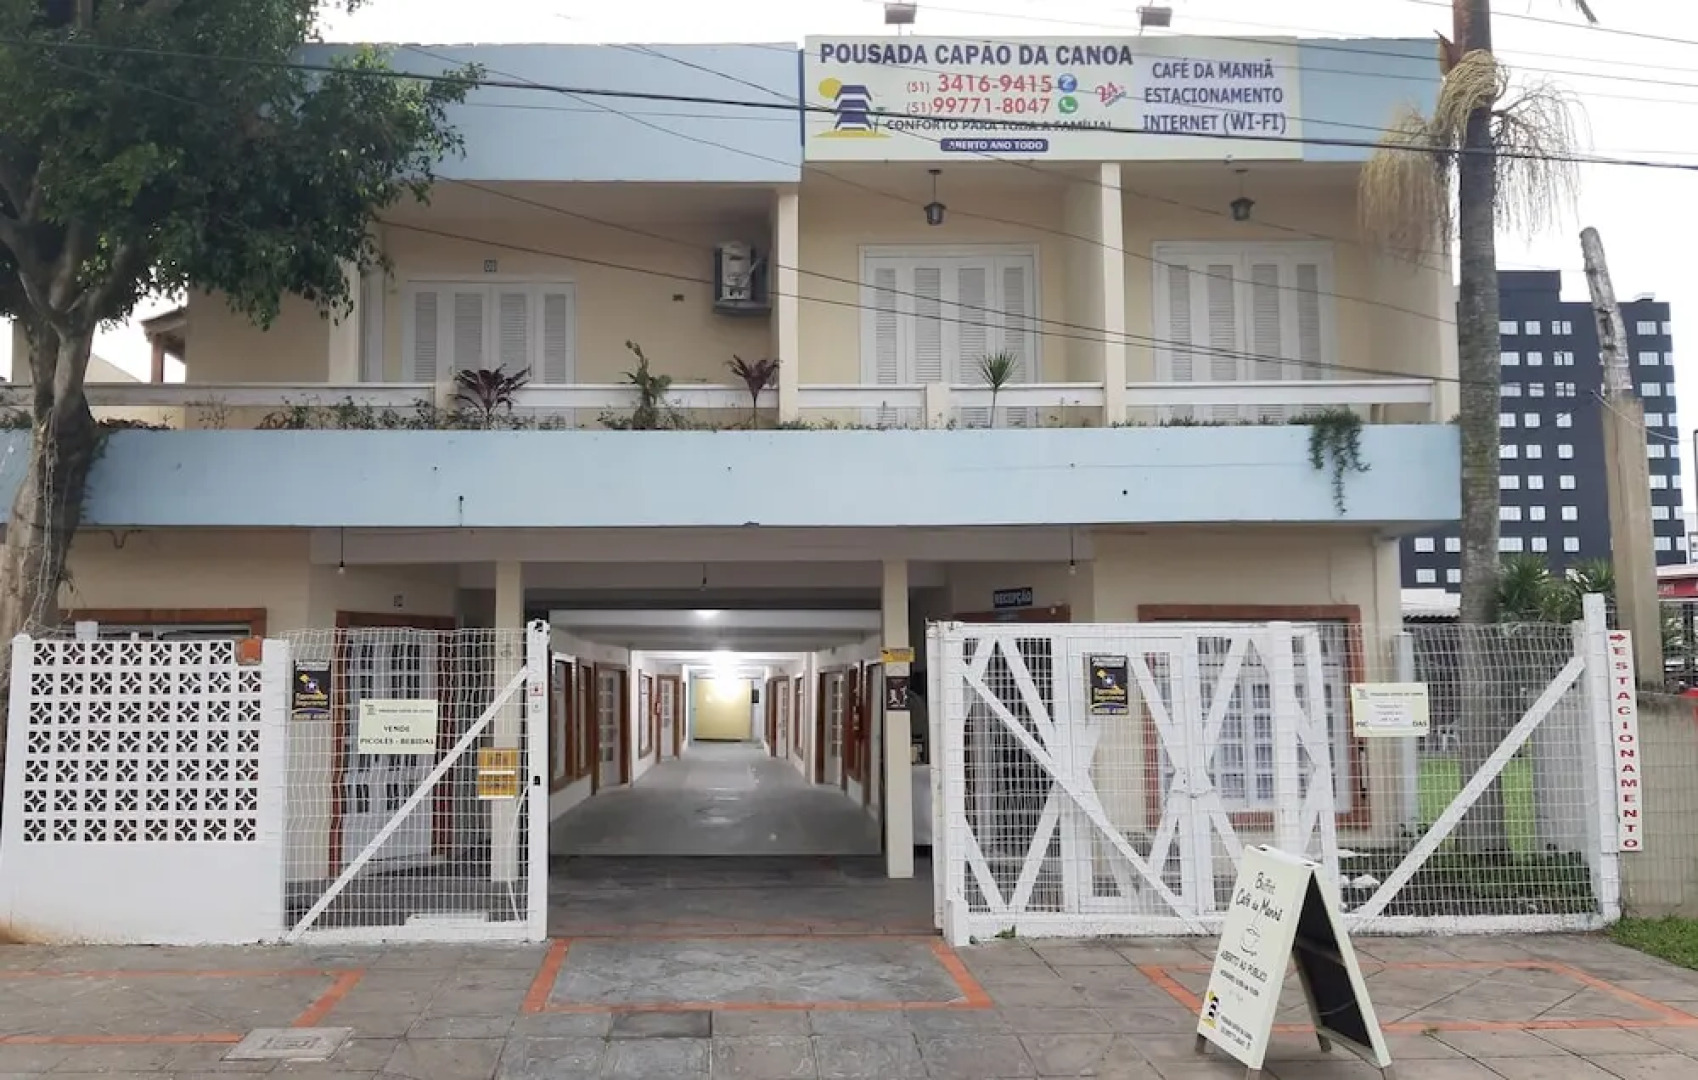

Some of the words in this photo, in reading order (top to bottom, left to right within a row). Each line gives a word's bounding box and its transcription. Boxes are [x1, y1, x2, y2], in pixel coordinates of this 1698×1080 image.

[821, 44, 928, 64] POUSADA
[935, 41, 1011, 65] CAPÃO
[1019, 46, 1048, 65] DA
[1056, 46, 1133, 65] CANOA
[1153, 58, 1190, 78] CAFÉ
[1194, 63, 1214, 78] DA
[1219, 58, 1274, 78] MANHÃ
[907, 81, 930, 93] (51)
[938, 74, 1052, 93] 3416-9415
[1144, 88, 1283, 103] ESTACIONAMENTO
[906, 101, 932, 117] (51)
[932, 97, 1050, 114] 99771-8047
[887, 120, 959, 131] CONFORTO
[1143, 115, 1218, 131] INTERNET
[1223, 112, 1286, 134] (WI-FI)
[990, 141, 1012, 150] ANO
[1014, 141, 1044, 150] TODO
[1612, 646, 1638, 848] ESTACIONAMENTO
